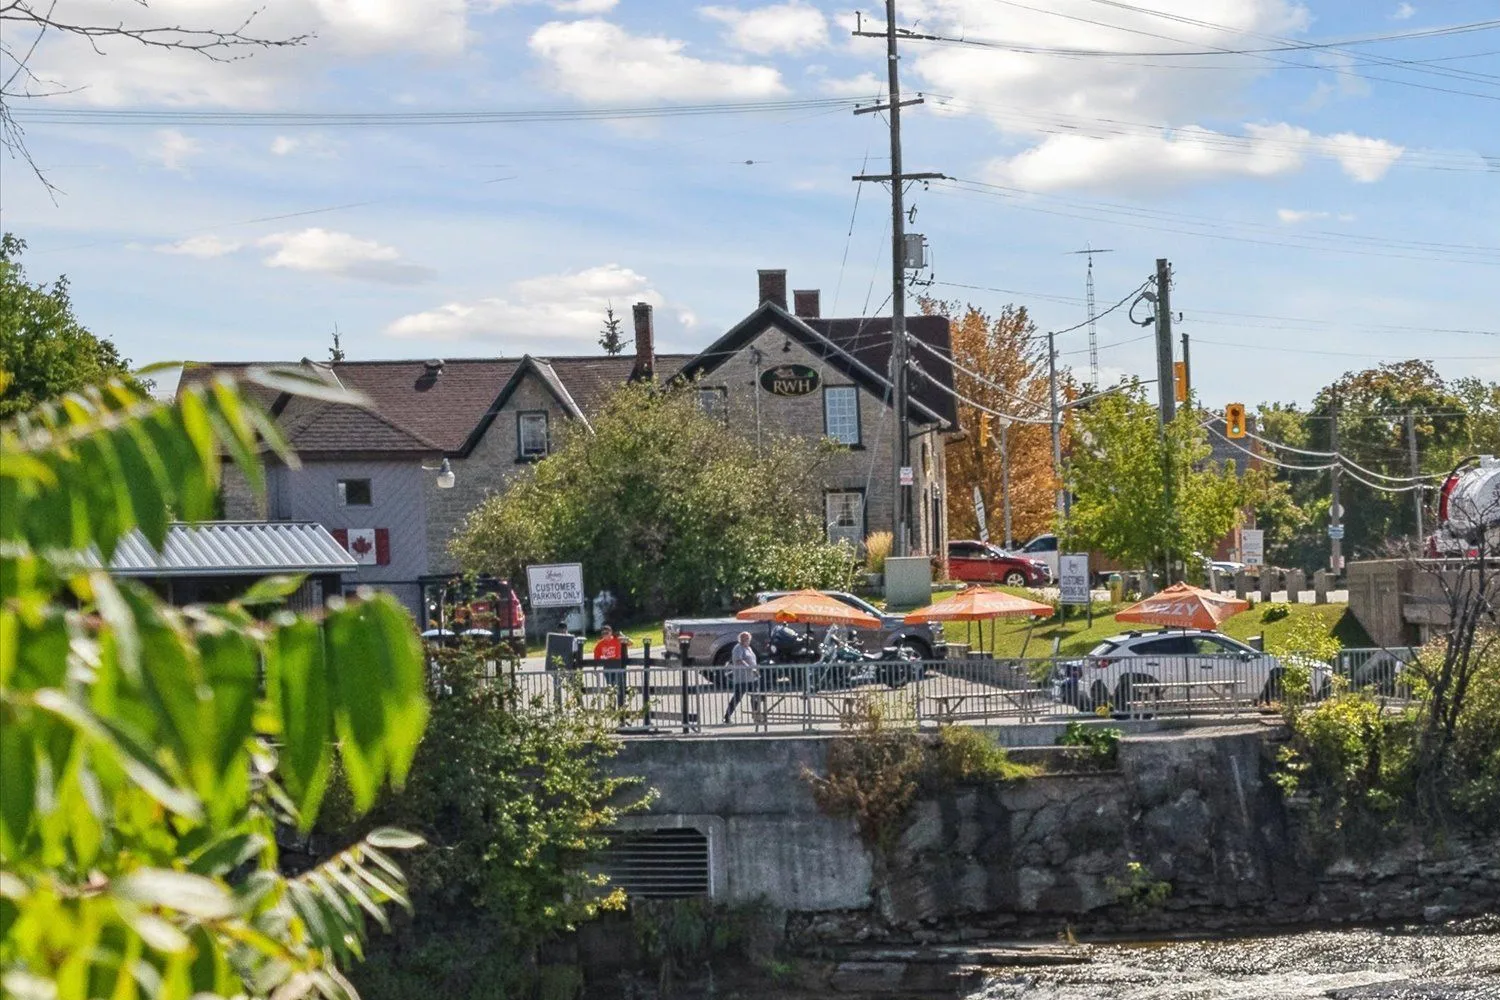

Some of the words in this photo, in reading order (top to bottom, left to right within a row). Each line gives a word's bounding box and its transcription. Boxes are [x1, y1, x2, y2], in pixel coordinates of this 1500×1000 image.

[773, 380, 811, 393] RWH
[535, 583, 576, 592] CUSTOMER
[532, 591, 562, 600] PARKING
[563, 590, 581, 600] ONLY
